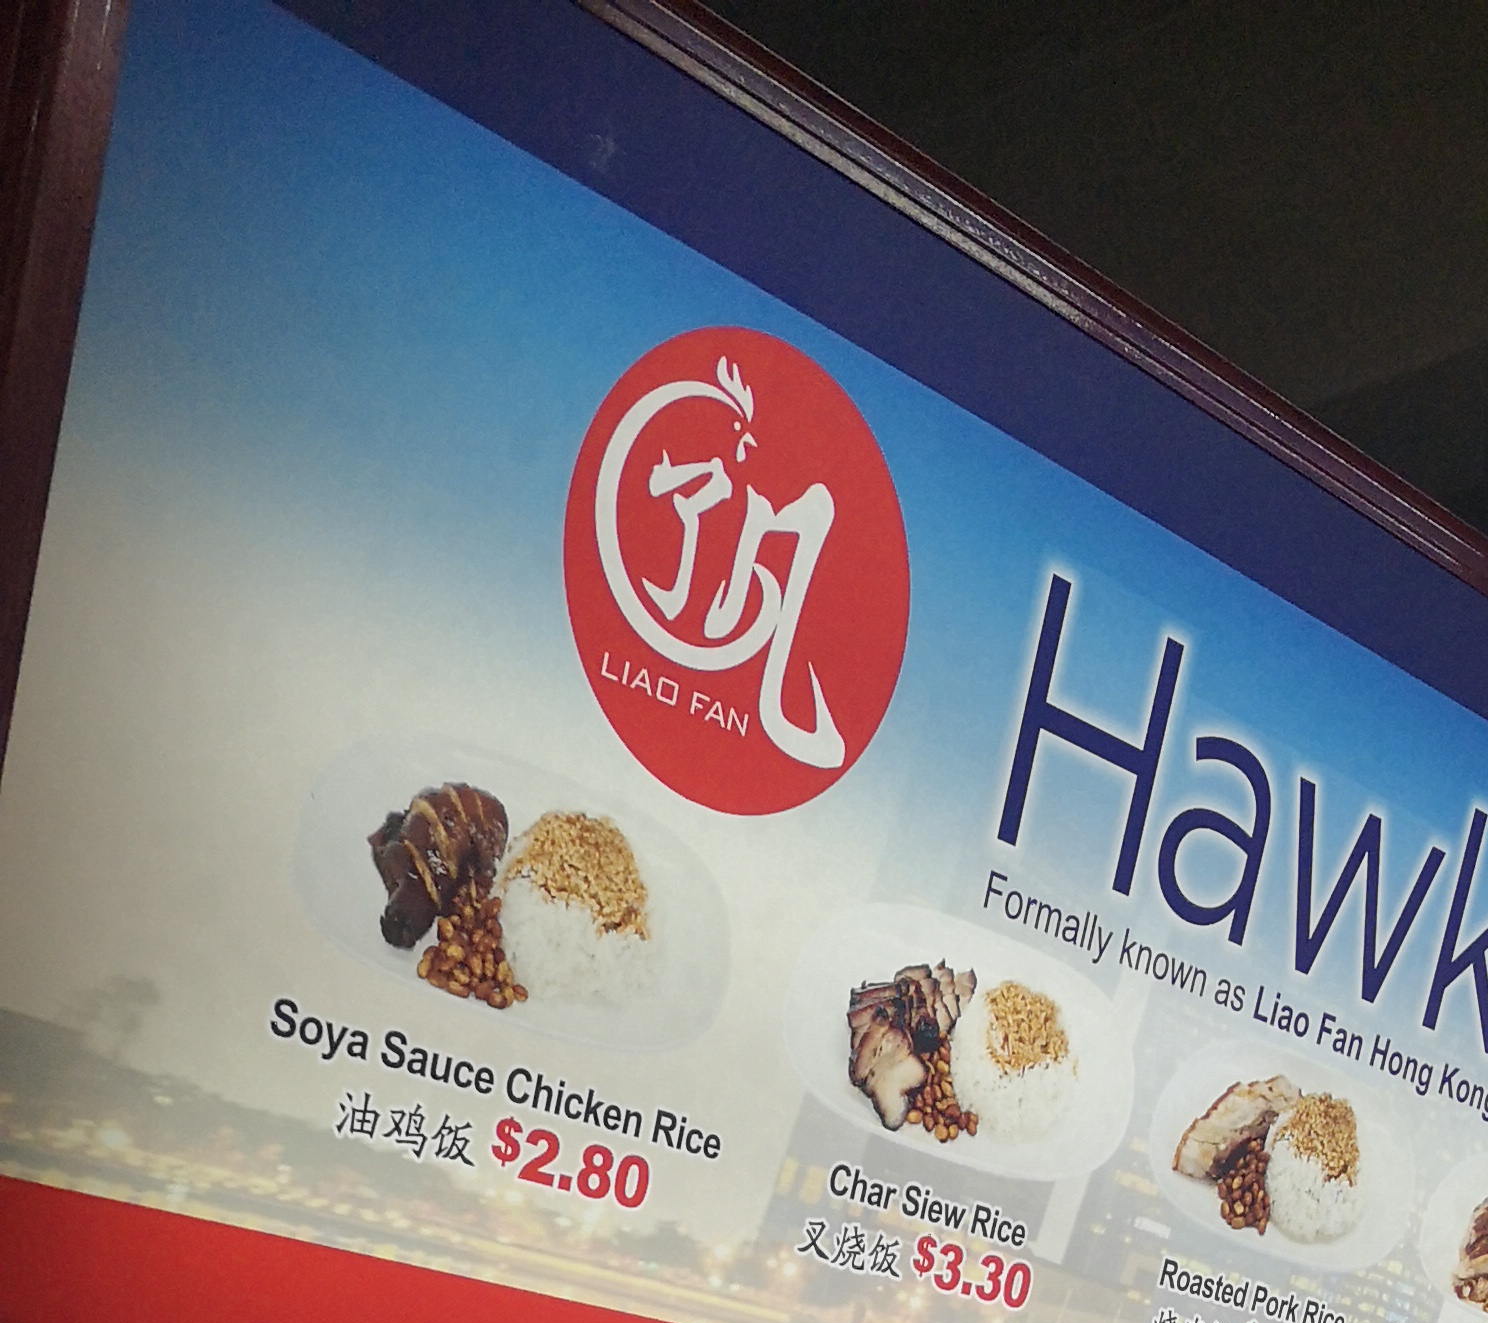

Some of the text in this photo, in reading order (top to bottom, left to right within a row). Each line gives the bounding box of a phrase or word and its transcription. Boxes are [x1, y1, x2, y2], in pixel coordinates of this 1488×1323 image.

[602, 651, 749, 737] LIAO FAN
[983, 870, 1113, 963] Formally
[1119, 928, 1207, 997] known
[1214, 975, 1245, 1012] as
[1253, 985, 1309, 1037] Liao
[1316, 1012, 1363, 1061] Fan
[1369, 1034, 1432, 1097] Hong
[271, 999, 723, 1161] Soya Sauce Chicken Rice
[334, 1090, 651, 1210] 油鸡饭 $2.80
[830, 1164, 1026, 1247] Char Siew Rice
[797, 1221, 1031, 1308] 叉烧饭 $3.30
[1159, 1258, 1249, 1308] Roasted
[1251, 1286, 1299, 1323] Pork
